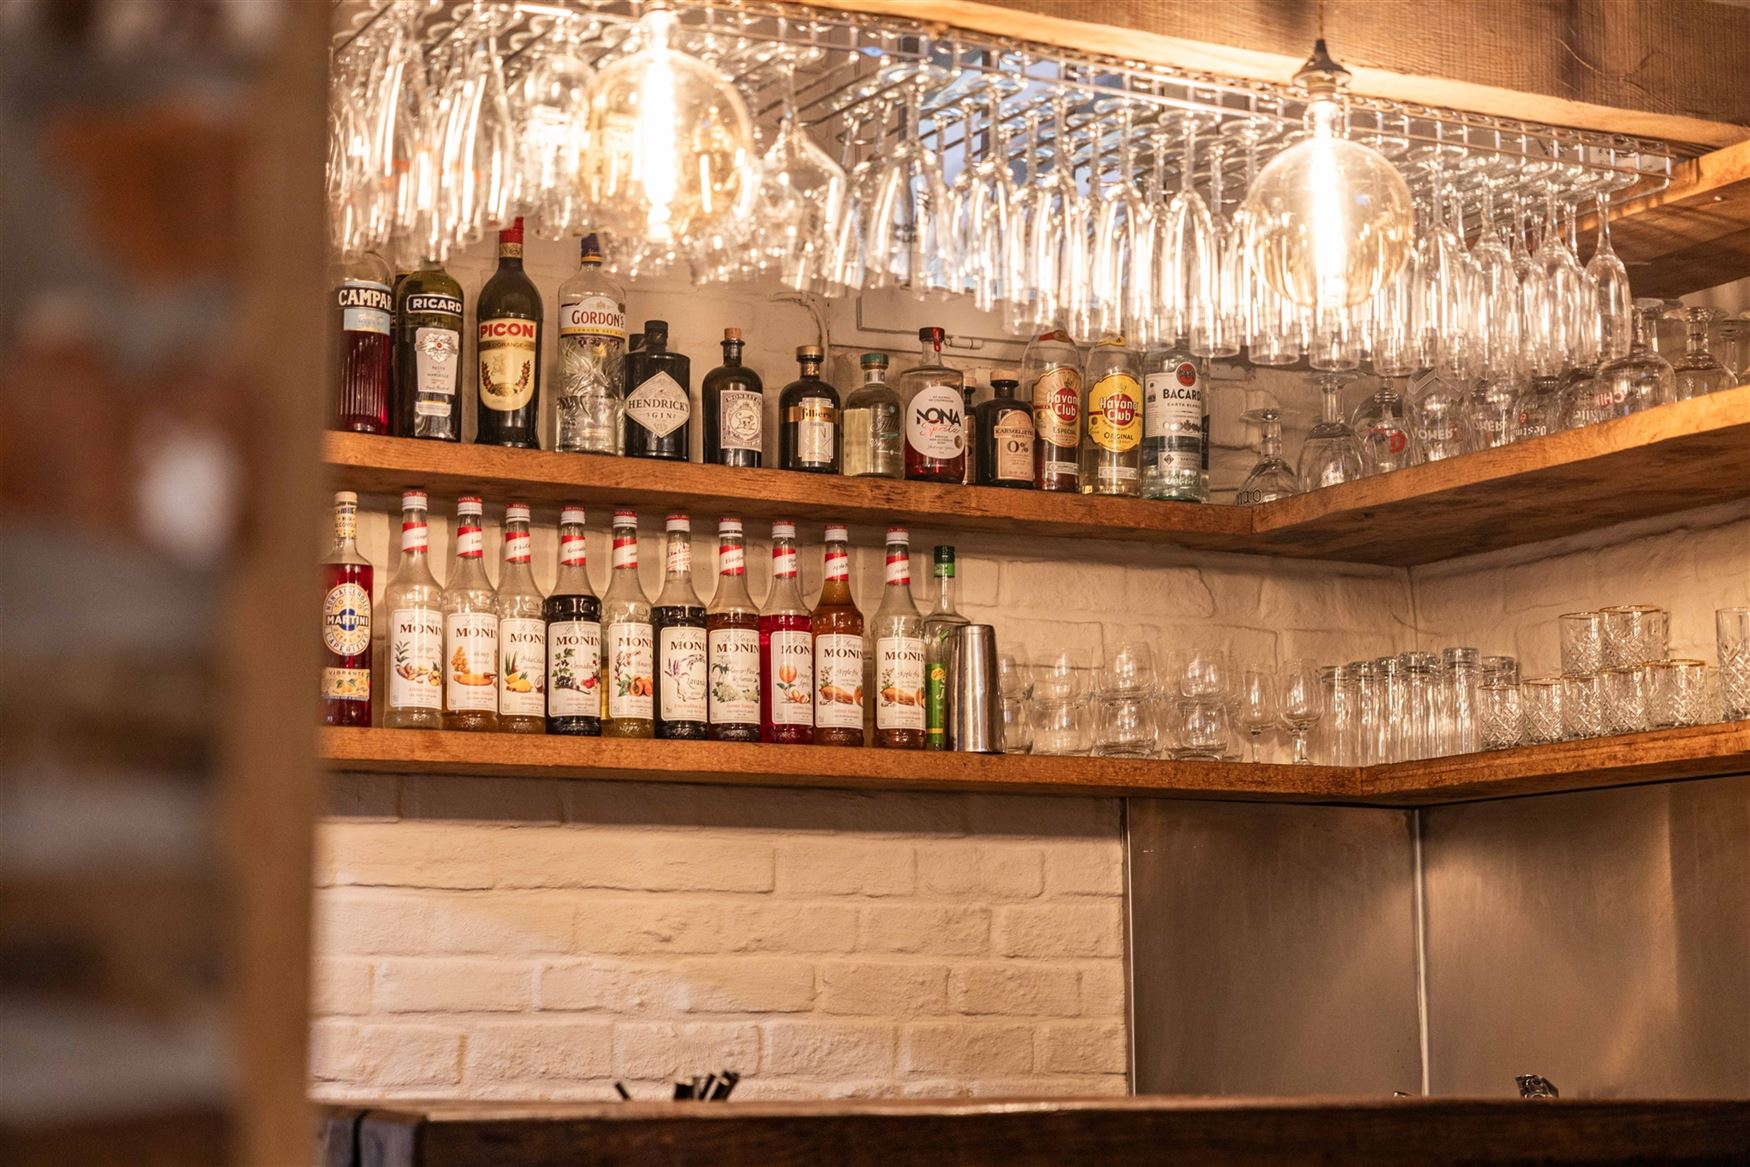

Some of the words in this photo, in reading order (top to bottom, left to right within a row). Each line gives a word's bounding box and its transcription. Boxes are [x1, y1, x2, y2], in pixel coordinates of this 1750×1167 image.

[412, 298, 462, 313] RICARD
[480, 323, 534, 338] PICON
[652, 411, 672, 419] GIN
[916, 407, 962, 427] NONA
[1055, 404, 1076, 416] Club
[1107, 409, 1131, 421] Club
[326, 614, 369, 628] MARTINI
